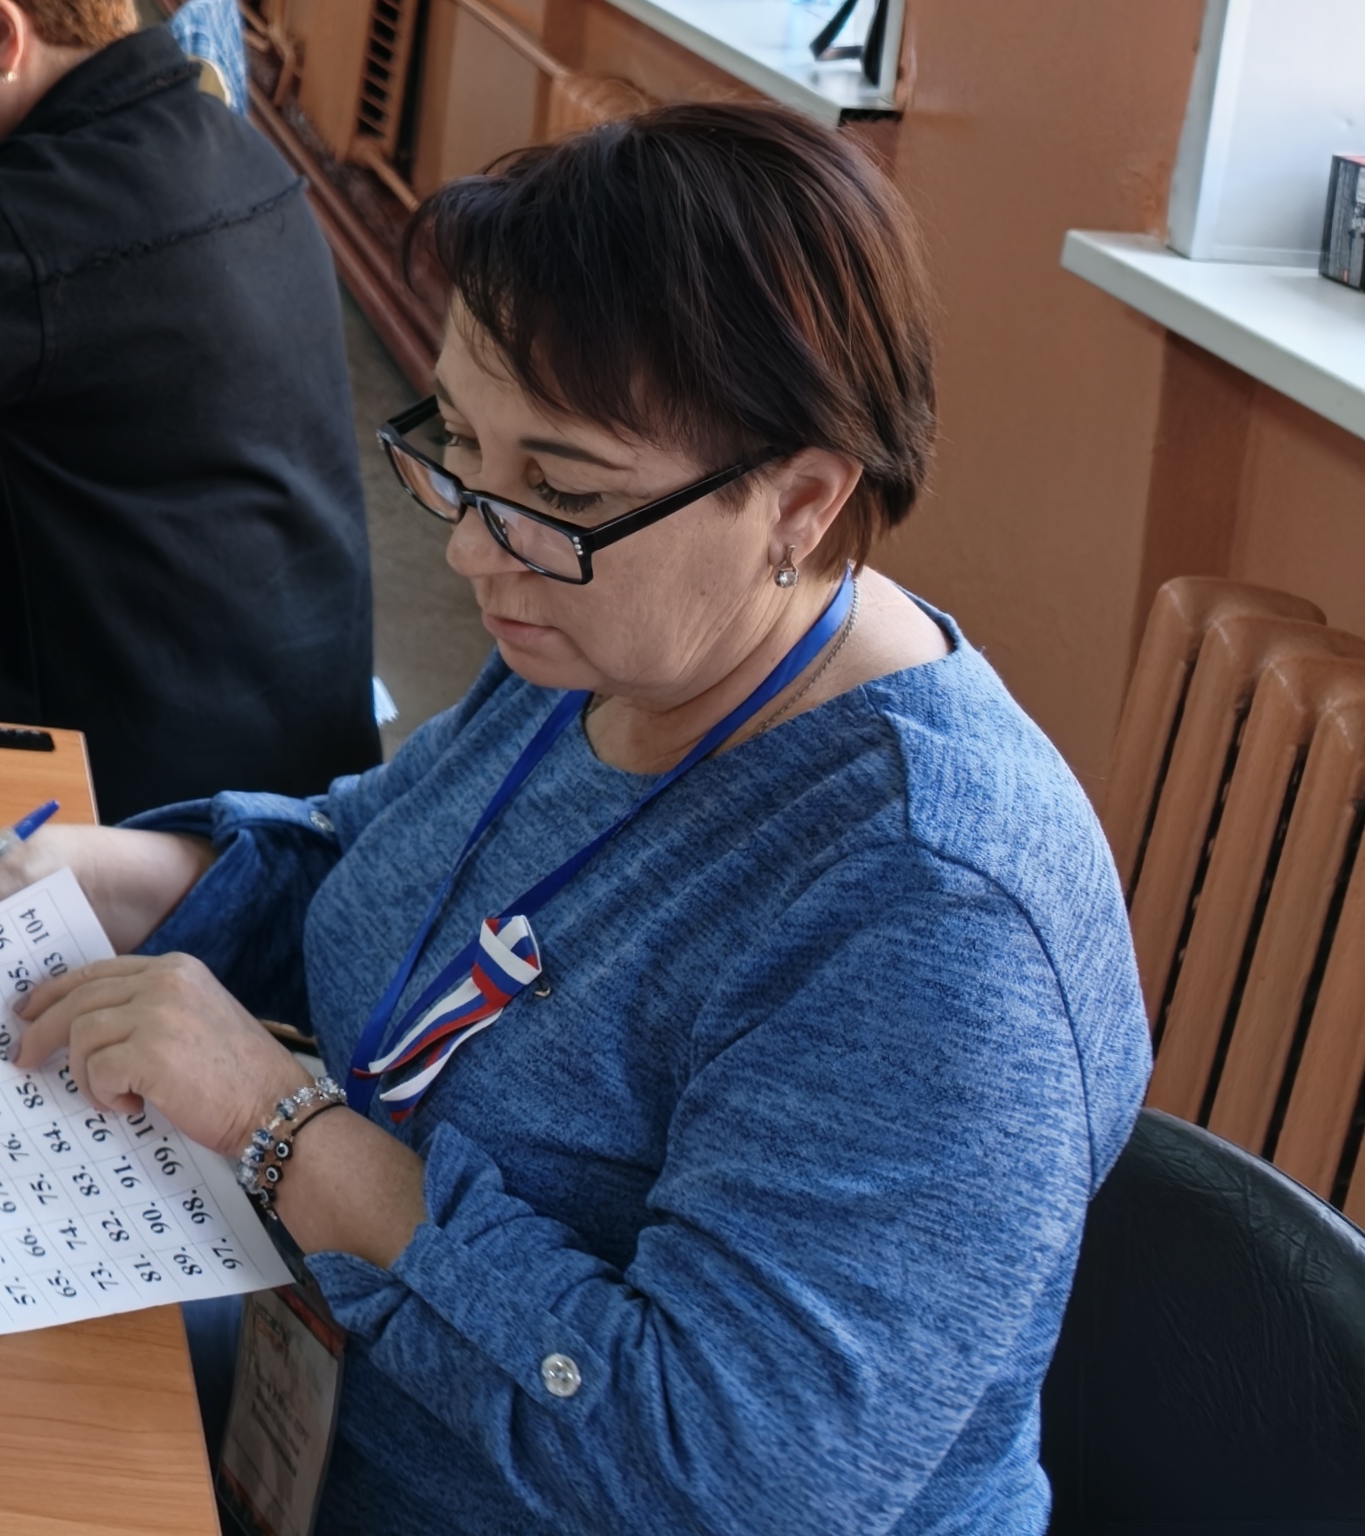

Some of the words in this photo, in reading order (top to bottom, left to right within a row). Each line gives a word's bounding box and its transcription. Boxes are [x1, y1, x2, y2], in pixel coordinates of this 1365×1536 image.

[19, 908, 51, 945] 104
[15, 1074, 44, 1110] 85.
[3, 1132, 29, 1163] 76.
[42, 1121, 72, 1154] 84.
[113, 1155, 140, 1189] 91.
[153, 1136, 183, 1177] 99.
[29, 1172, 58, 1206] 75.
[71, 1164, 101, 1197] 83.
[141, 1201, 171, 1235] 90.
[182, 1188, 212, 1225] 98.
[19, 1227, 46, 1258] 66.
[58, 1218, 87, 1251] 74.
[101, 1209, 130, 1243] 82.
[133, 1253, 162, 1283] 81.
[172, 1246, 203, 1276] 89.
[211, 1237, 242, 1270] 97.
[4, 1276, 37, 1306] 57.
[46, 1269, 78, 1298] 65.
[90, 1261, 119, 1291] 73.
